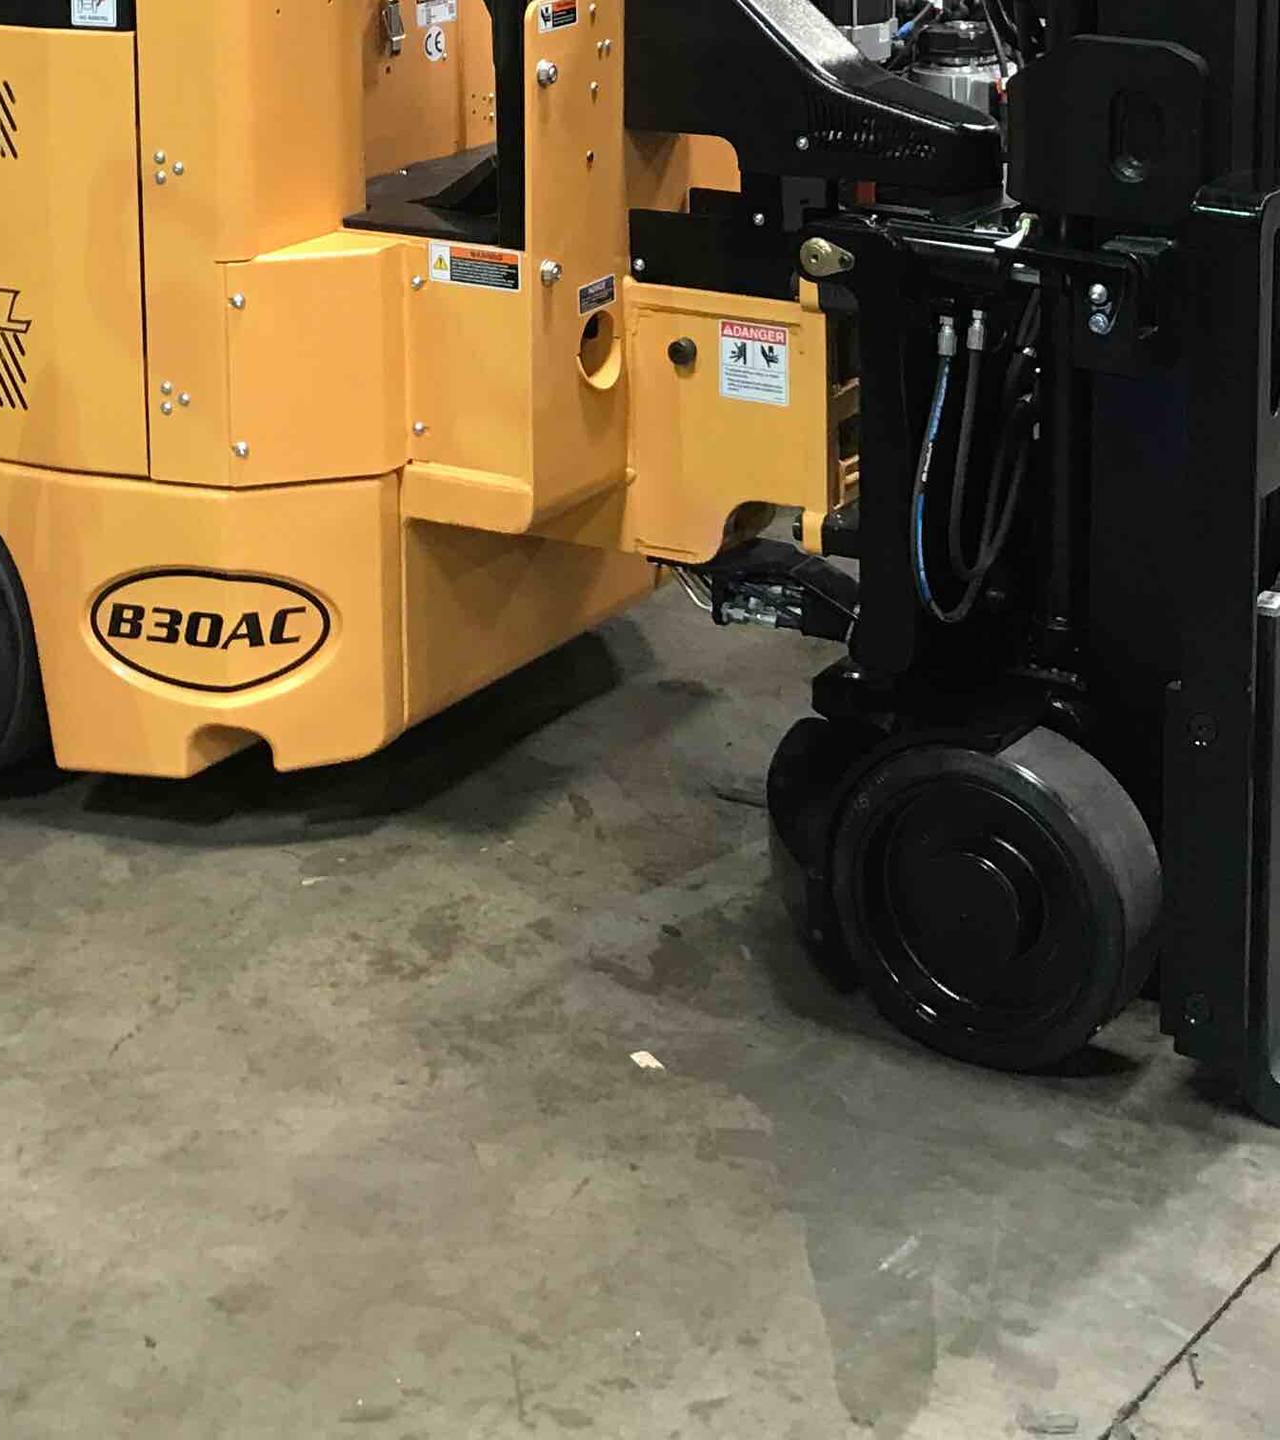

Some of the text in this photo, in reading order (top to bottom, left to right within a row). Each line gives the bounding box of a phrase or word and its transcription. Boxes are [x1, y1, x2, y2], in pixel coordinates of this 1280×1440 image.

[425, 31, 443, 56] CE
[733, 325, 785, 343] DANGER
[107, 602, 307, 650] B30AC
